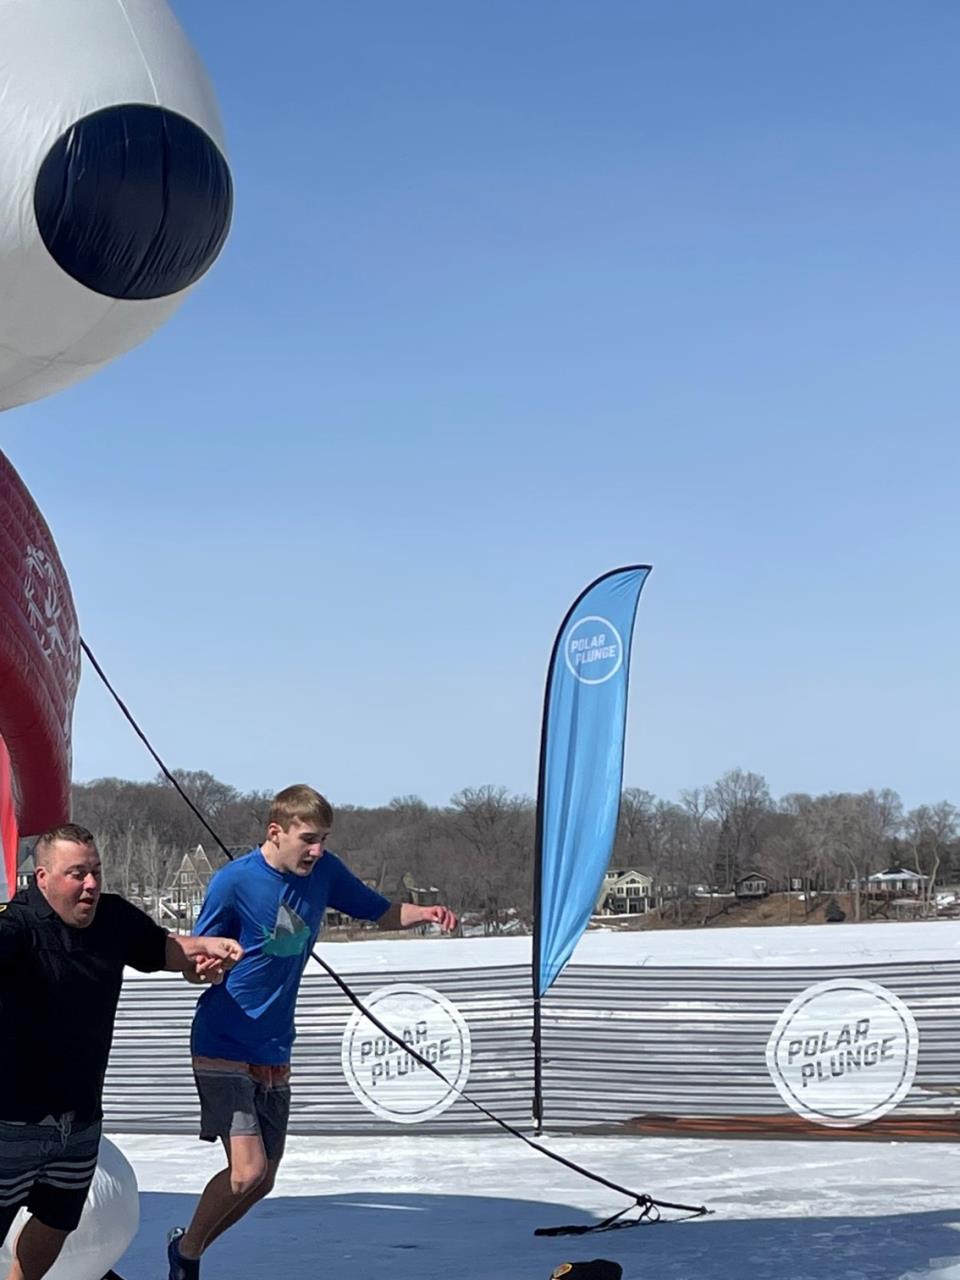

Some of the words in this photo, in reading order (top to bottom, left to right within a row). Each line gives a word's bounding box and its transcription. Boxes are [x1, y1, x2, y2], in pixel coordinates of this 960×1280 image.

[571, 634, 606, 653] POLAR
[575, 645, 617, 665] PLUNGE
[788, 1018, 870, 1064] POLAR
[801, 1036, 896, 1087] PLUNGE
